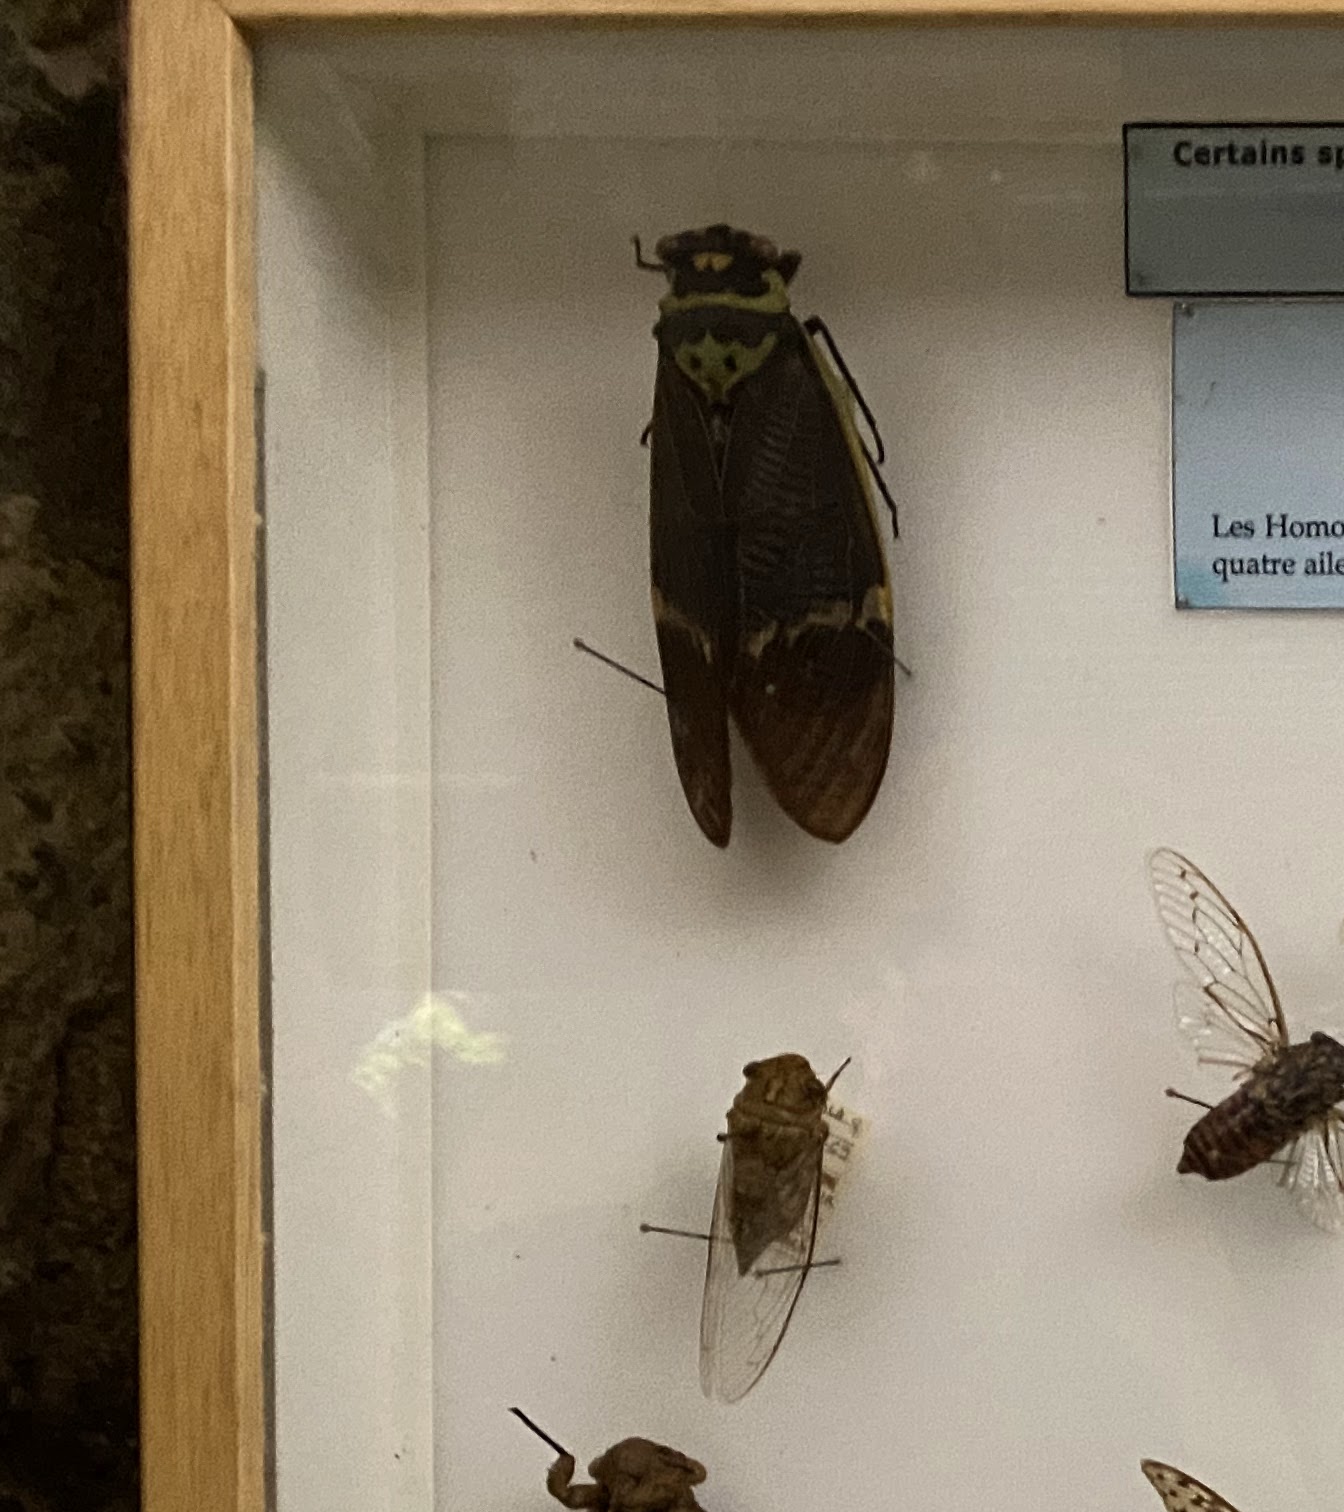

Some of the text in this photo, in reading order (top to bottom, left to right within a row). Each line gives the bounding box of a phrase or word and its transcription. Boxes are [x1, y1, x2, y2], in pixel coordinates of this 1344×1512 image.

[1172, 139, 1305, 166] Certains
[1211, 511, 1255, 540] Les
[1211, 553, 1297, 585] quatre
